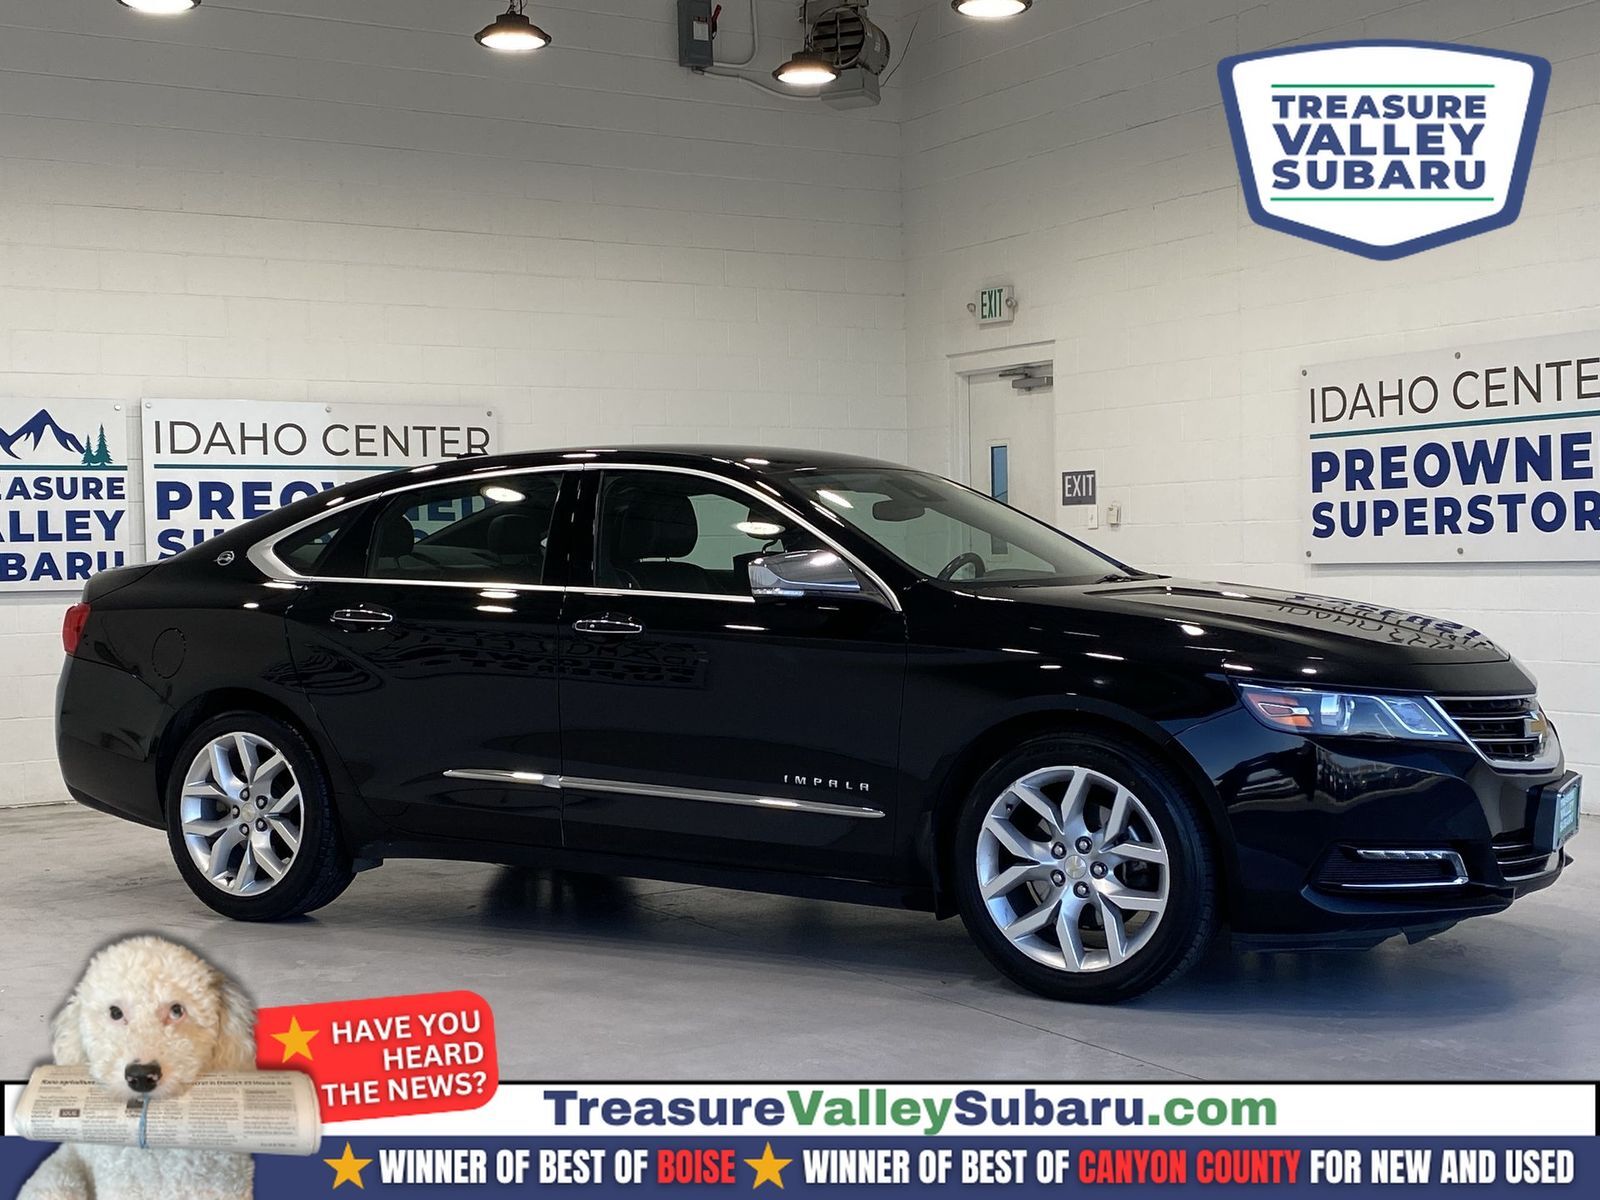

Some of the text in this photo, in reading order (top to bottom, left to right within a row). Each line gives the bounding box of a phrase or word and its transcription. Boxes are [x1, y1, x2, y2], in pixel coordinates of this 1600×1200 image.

[981, 288, 1003, 319] EXIT
[1309, 374, 1439, 424] IDAHO
[154, 420, 490, 457] IDAHO CENTER
[1311, 431, 1594, 493] PREOWNE
[0, 476, 126, 500] ASURE
[1064, 473, 1095, 498] EXIT
[0, 509, 126, 543] LLEY
[1312, 490, 1600, 538] SUPERSTOR
[784, 774, 870, 792] IMPALA
